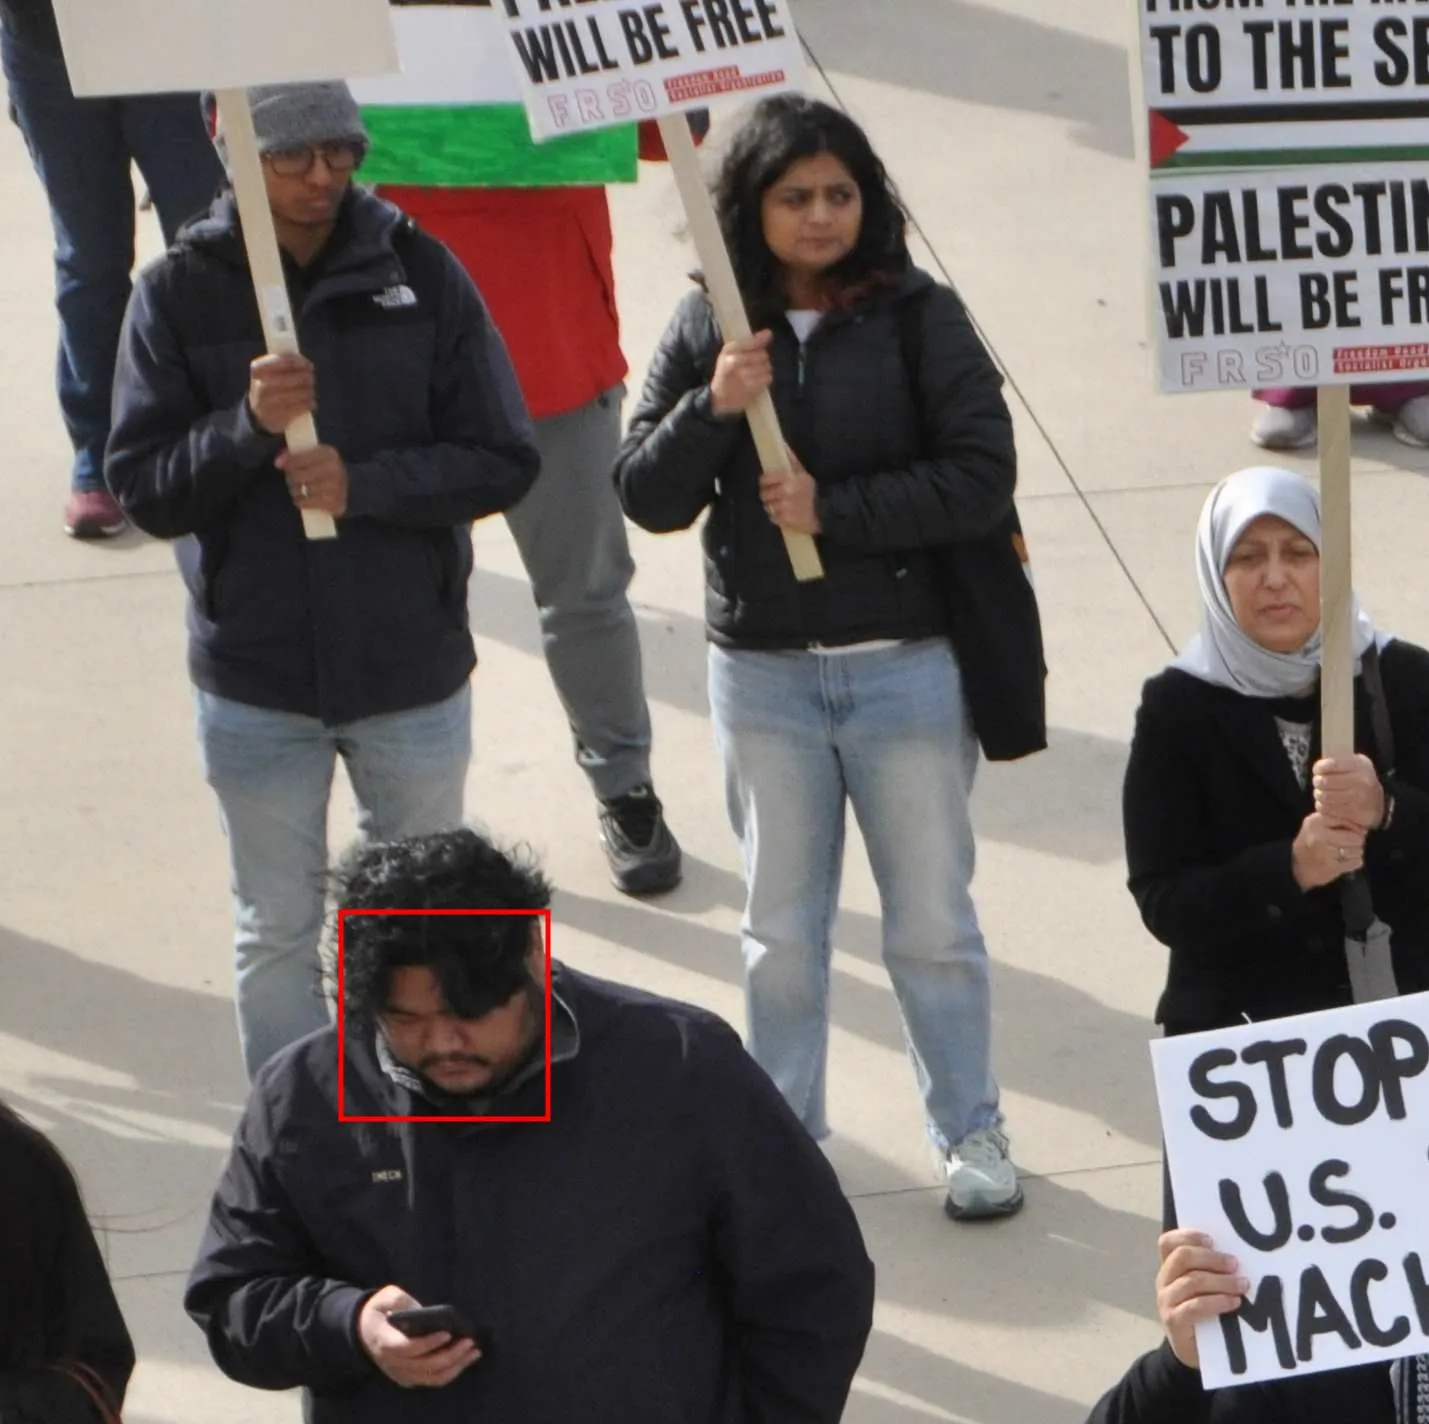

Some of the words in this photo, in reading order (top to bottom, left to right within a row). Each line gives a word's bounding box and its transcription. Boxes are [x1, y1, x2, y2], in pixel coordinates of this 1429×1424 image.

[510, 15, 619, 84] WILL
[617, 4, 680, 65] BE
[679, 0, 785, 52] FREE
[1150, 23, 1222, 94] TO
[1243, 19, 1352, 90] THE
[547, 78, 657, 129] FRSO
[1159, 275, 1283, 339] WILL
[1299, 270, 1361, 330] BE
[1181, 344, 1319, 385] FRSO
[1188, 1018, 1429, 1140] STOP
[1218, 1158, 1397, 1252] U.S.
